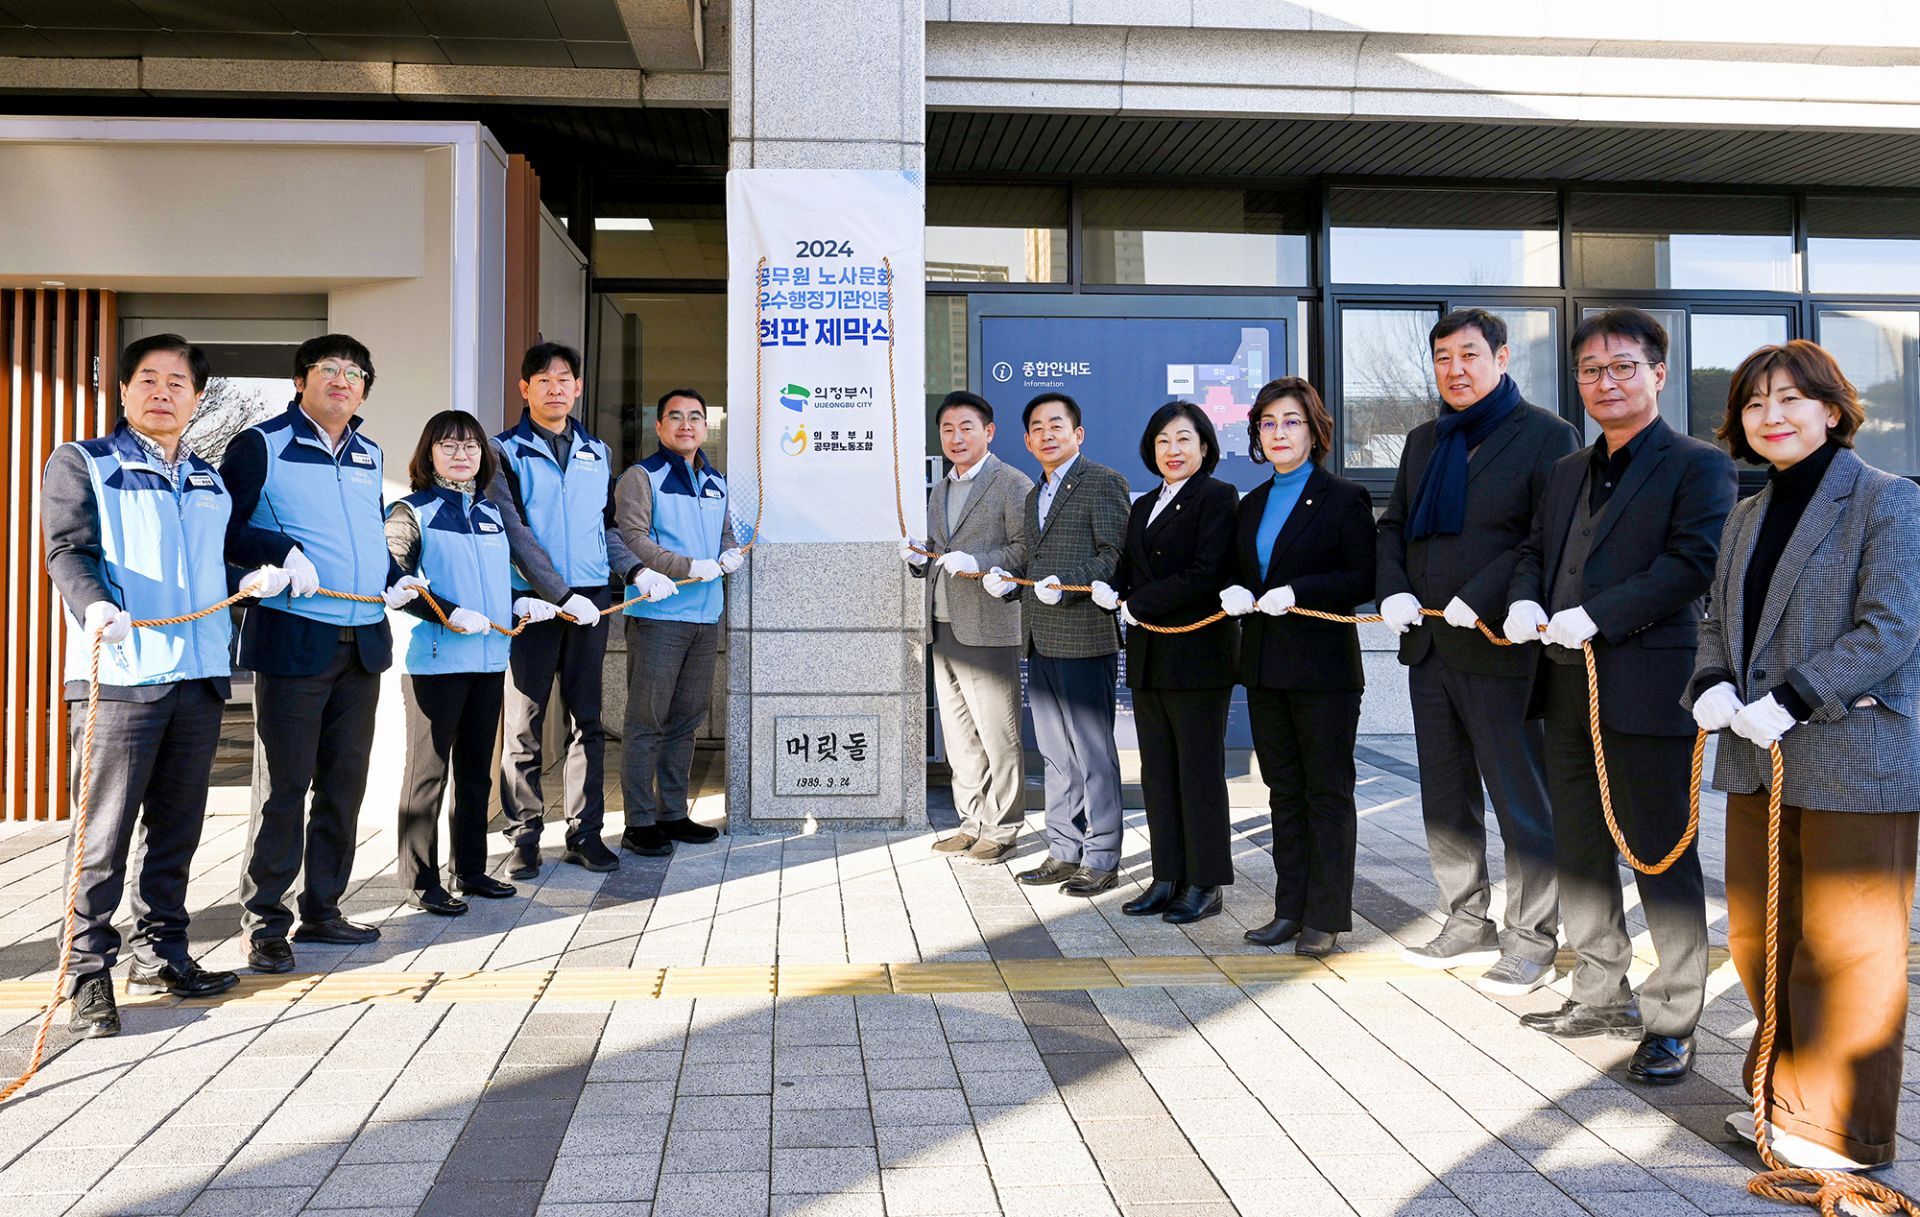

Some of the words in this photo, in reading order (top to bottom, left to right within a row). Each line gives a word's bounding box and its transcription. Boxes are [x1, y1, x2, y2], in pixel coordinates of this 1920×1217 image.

[796, 239, 854, 258] 2024
[756, 266, 810, 287] 공무원
[818, 266, 894, 286] 노사문화
[755, 290, 894, 311] 우수행정기관인증
[756, 317, 809, 347] 현판
[1022, 361, 1092, 377] 종합안내도
[1023, 380, 1064, 388] Information
[814, 386, 873, 400] 의정부시
[814, 401, 855, 409] UIJEONGBU
[814, 441, 873, 452] 공무원노동조합
[786, 732, 868, 762] 머릿돌
[796, 777, 821, 787] 1989.
